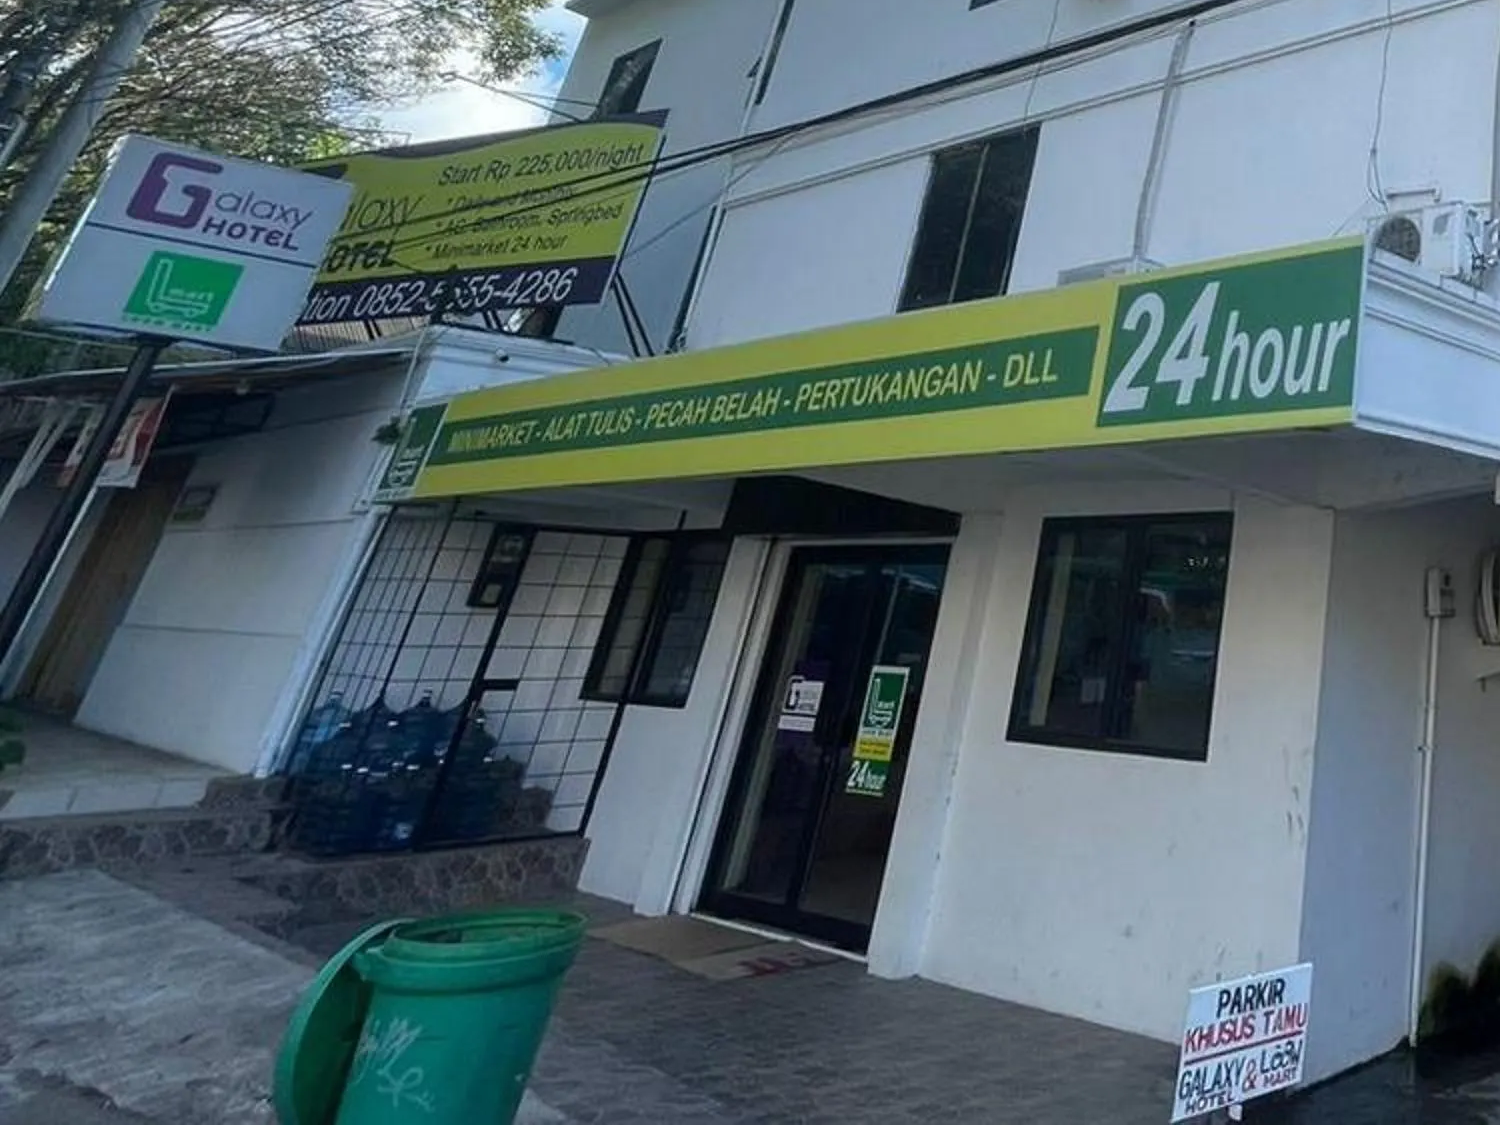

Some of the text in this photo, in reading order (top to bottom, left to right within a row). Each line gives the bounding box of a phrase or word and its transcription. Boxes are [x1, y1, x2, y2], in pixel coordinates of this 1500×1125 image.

[126, 152, 314, 229] Galaxy
[438, 162, 482, 186] Start
[484, 160, 512, 184] Rp
[202, 217, 299, 251] HOTEL
[1103, 281, 1351, 412] 24 hour
[541, 412, 586, 443] ALAT
[586, 406, 635, 436] TULIS
[643, 396, 711, 430] PECAH
[710, 387, 782, 423] BELAH
[793, 360, 983, 413] PERTUKANGAN
[1003, 348, 1058, 388] DLL
[1216, 978, 1285, 1017] PARKIR
[1185, 1003, 1308, 1053] KHUSUS TAMU
[1179, 1057, 1246, 1100] GALAXY
[1186, 1090, 1235, 1115] HOTEL
